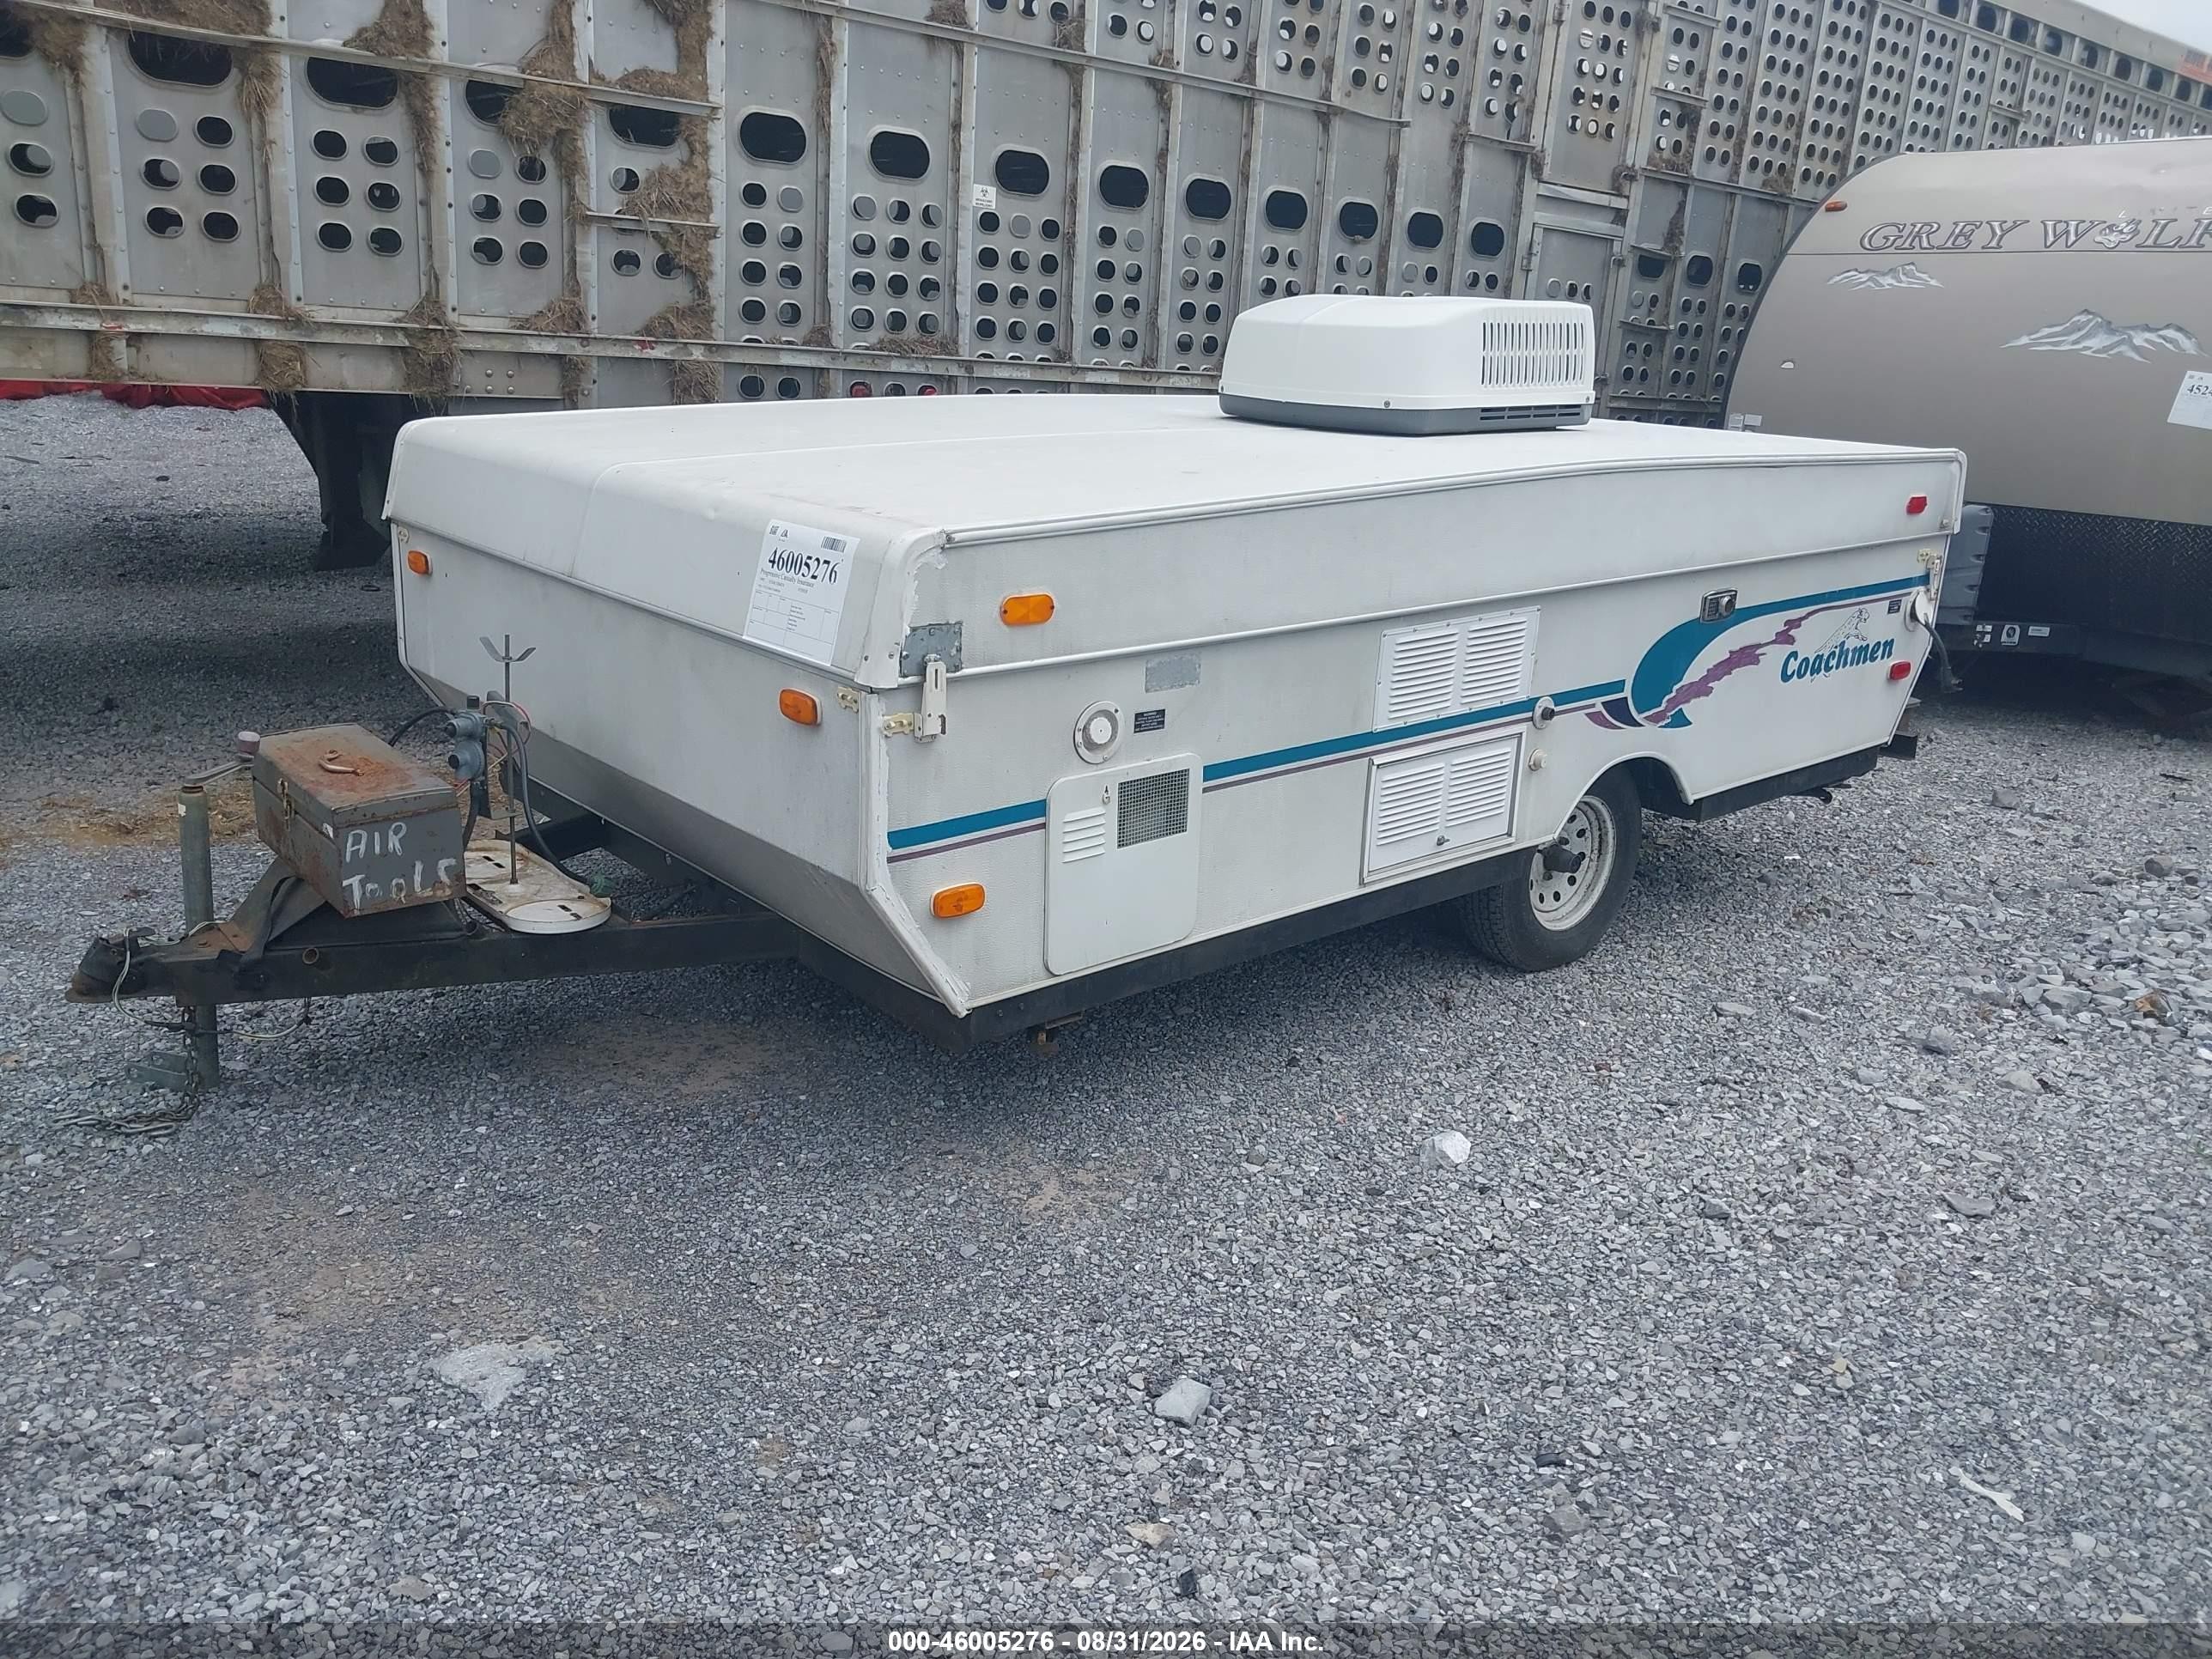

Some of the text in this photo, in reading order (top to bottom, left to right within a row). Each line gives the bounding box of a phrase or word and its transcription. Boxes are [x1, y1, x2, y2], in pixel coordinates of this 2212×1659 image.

[1860, 219, 2030, 251] GREY
[768, 547, 841, 585] 46005276
[1780, 637, 1895, 684] Coachmen
[345, 822, 407, 863] AIR
